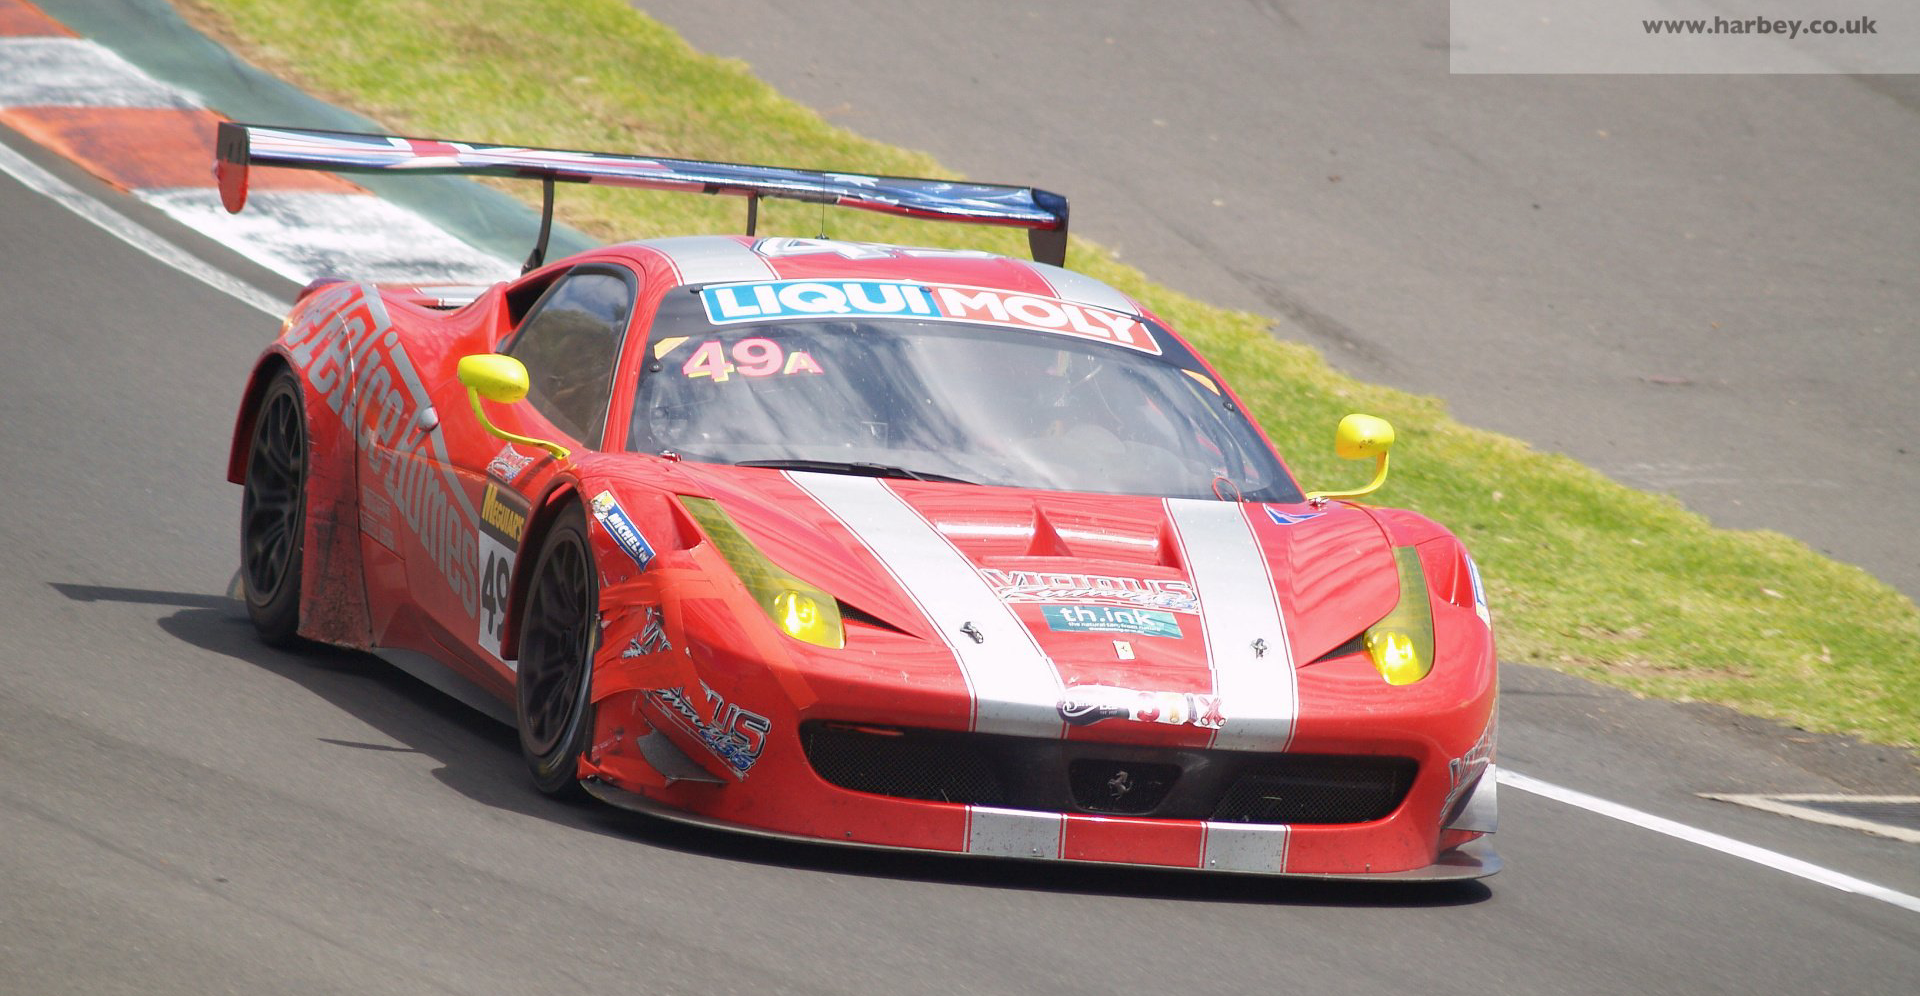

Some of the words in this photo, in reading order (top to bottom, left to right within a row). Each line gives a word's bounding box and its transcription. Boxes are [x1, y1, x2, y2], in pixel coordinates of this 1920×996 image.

[720, 282, 932, 318] LIQUI
[945, 289, 1136, 343] MOLY
[682, 337, 824, 382] 49A
[607, 512, 649, 563] MICHELIN
[979, 568, 1198, 602] VICIOUS
[1060, 606, 1155, 626] th.ink
